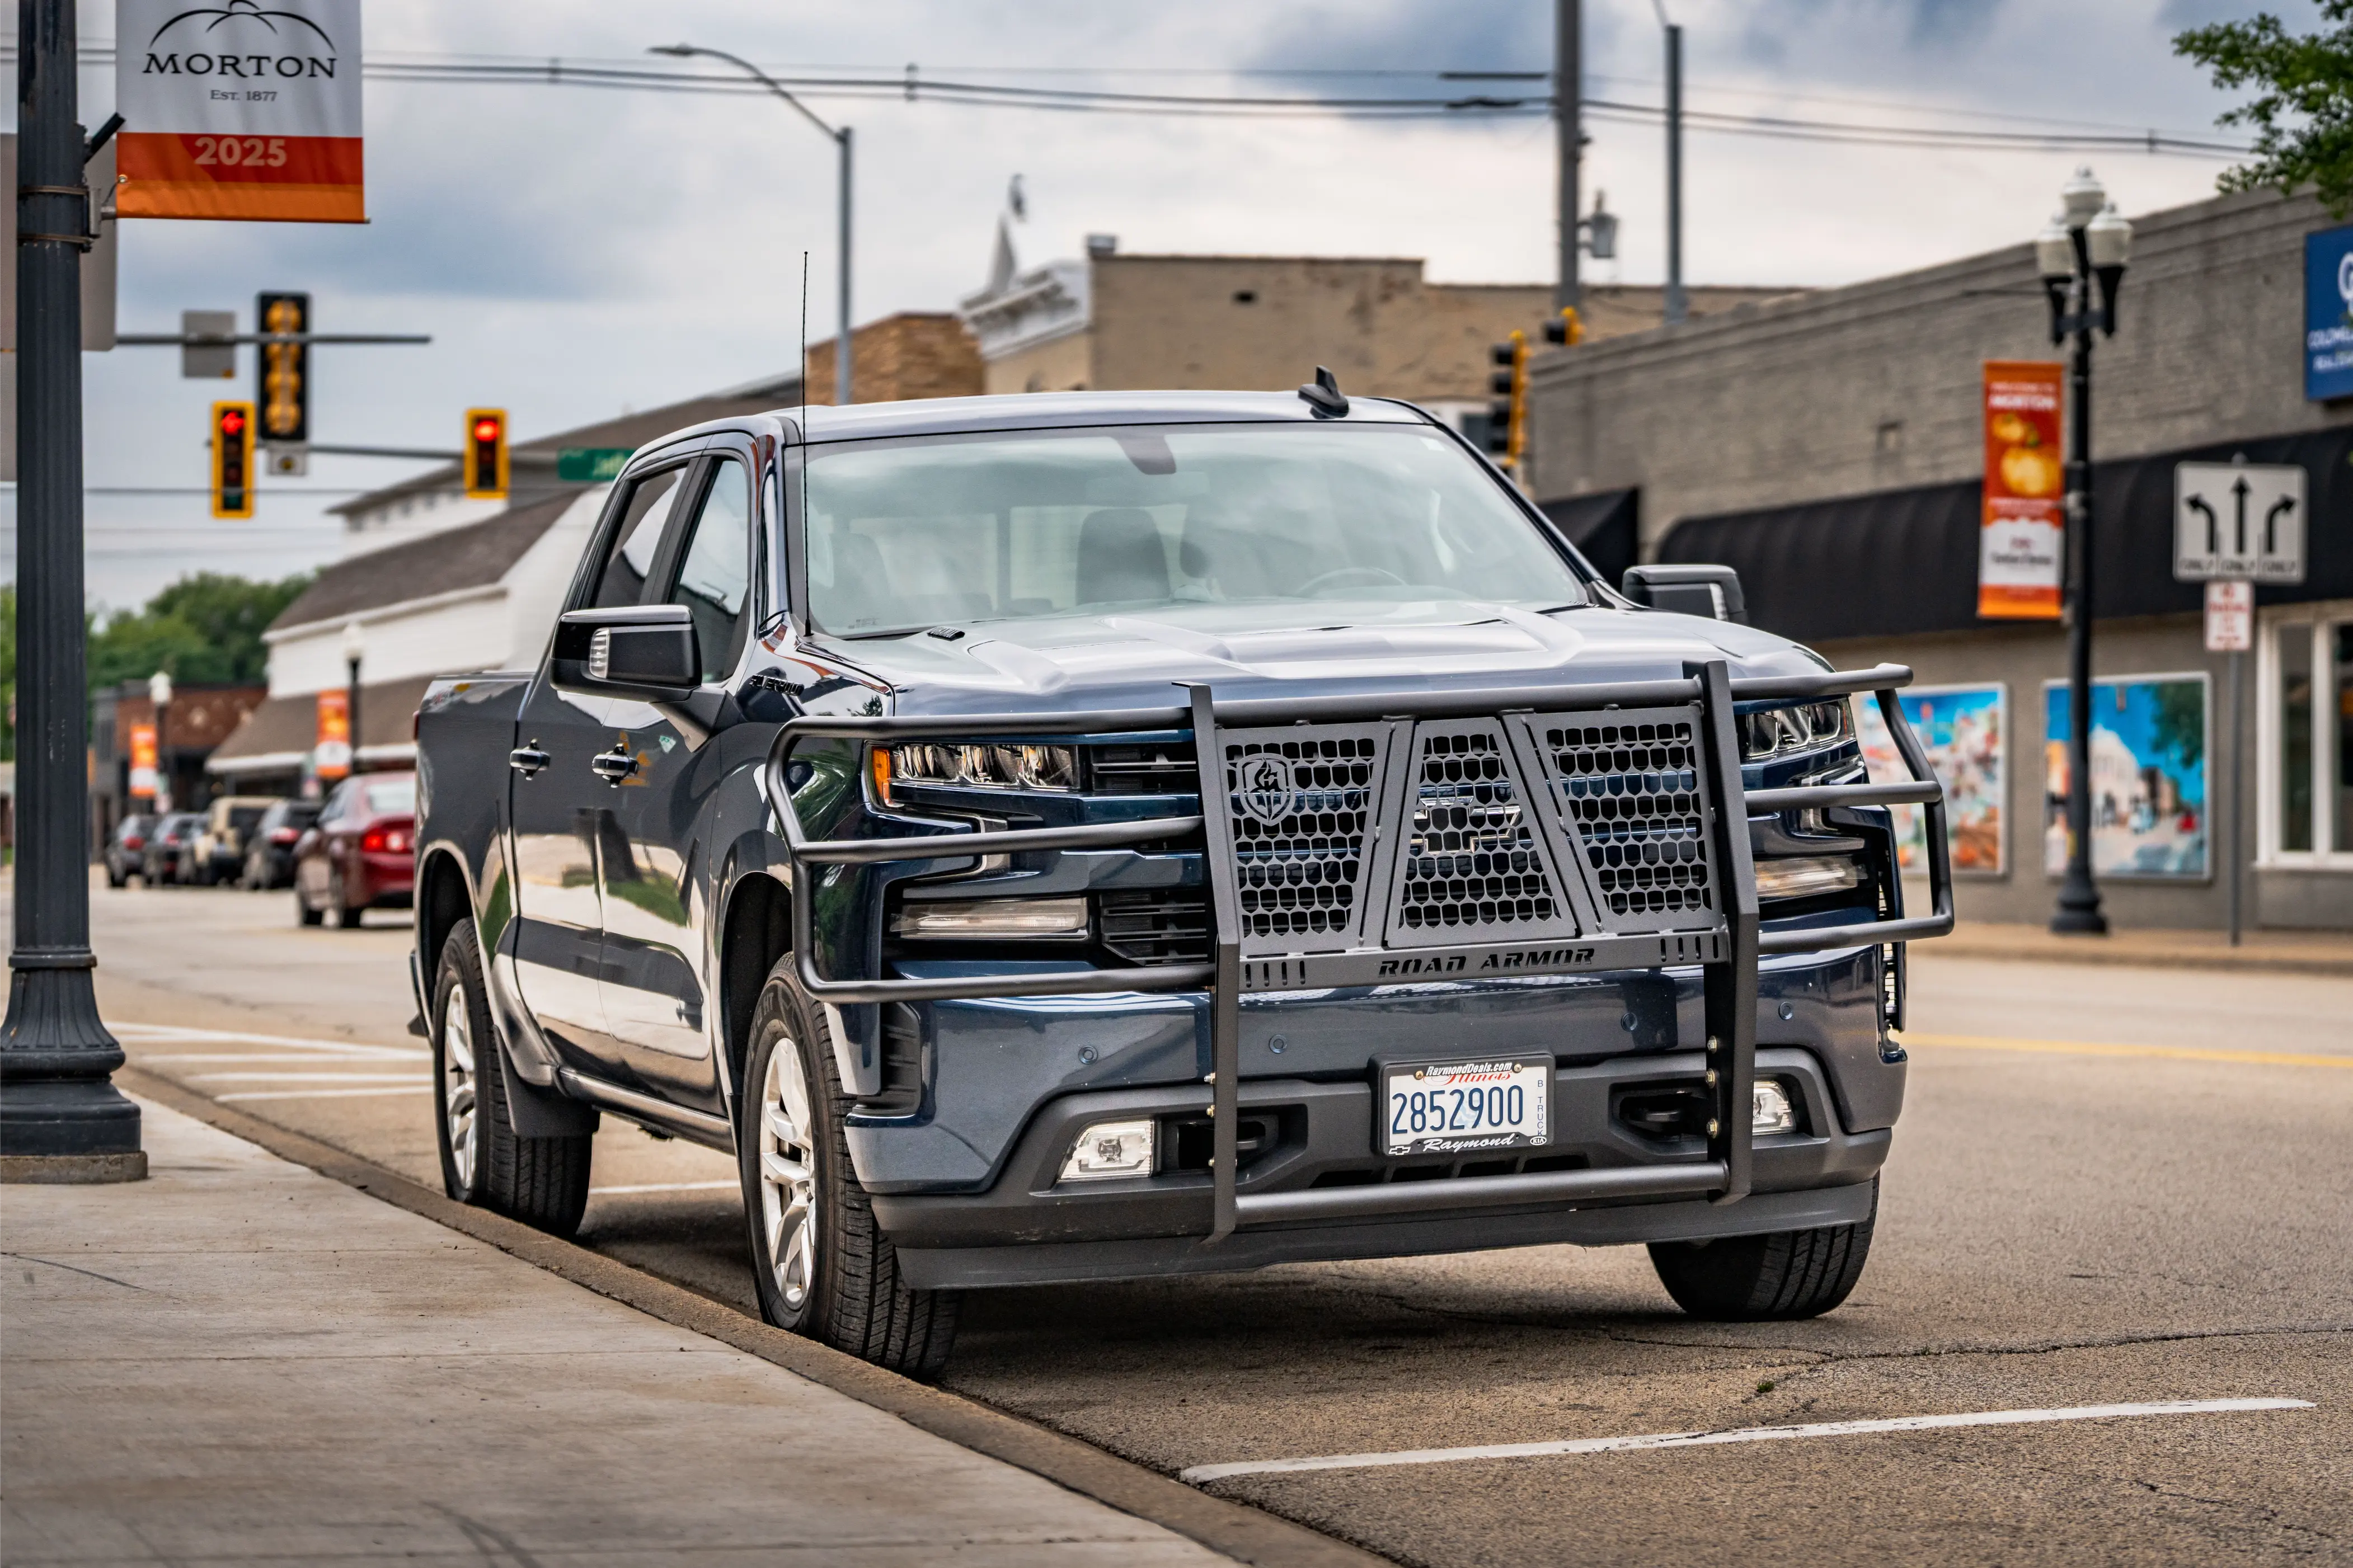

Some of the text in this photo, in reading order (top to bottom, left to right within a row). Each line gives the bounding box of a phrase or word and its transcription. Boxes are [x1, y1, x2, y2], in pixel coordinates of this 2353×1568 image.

[142, 53, 337, 79] MORTON
[246, 90, 278, 102] 1877
[194, 136, 287, 167] 2025
[1378, 948, 1595, 978] ROAD ARMOR
[1426, 1062, 1513, 1076] RaymondDeals.com
[1391, 1084, 1524, 1135] 2852900
[1422, 1132, 1515, 1153] Raymond
